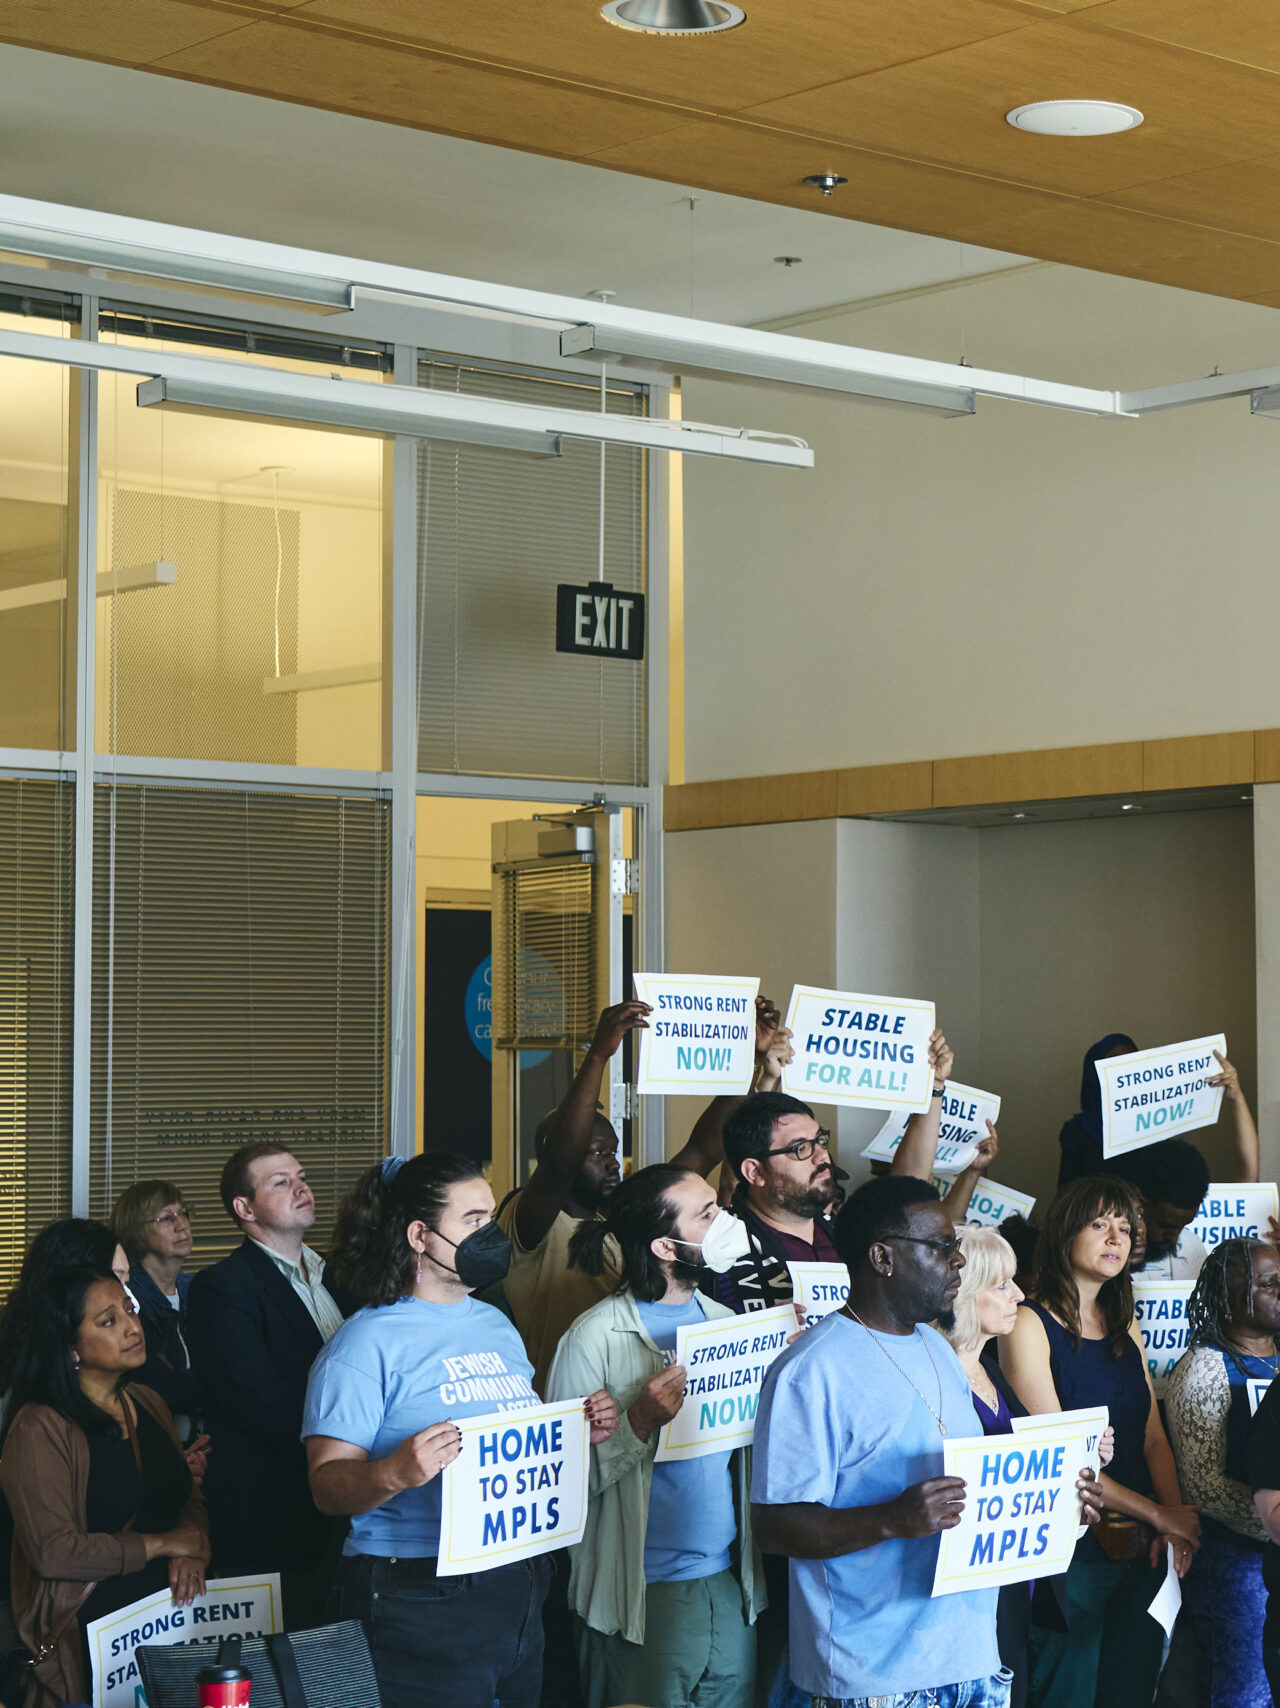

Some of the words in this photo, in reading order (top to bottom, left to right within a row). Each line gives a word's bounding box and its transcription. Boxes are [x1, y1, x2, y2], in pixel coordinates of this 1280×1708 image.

[575, 594, 634, 650] EXIT
[658, 995, 712, 1012] STRONG
[717, 998, 747, 1013] RENT
[655, 1022, 748, 1041] STABILIZATION
[822, 1008, 906, 1035] STABLE
[677, 1046, 731, 1071] NOW!
[806, 1034, 914, 1064] HOUSING
[805, 1062, 851, 1086] FOR
[857, 1069, 908, 1091] ALL!
[1117, 1065, 1174, 1088] STRONG
[1178, 1056, 1212, 1074] RENT
[942, 1095, 977, 1122] ABLE
[1136, 1099, 1194, 1132] NOW!
[1195, 1199, 1245, 1218] ABLE
[690, 1339, 749, 1365] STRONG
[752, 1331, 786, 1353] RENT
[442, 1352, 508, 1381] JEWISH
[479, 1420, 562, 1467] HOME
[479, 1474, 508, 1502] TO
[516, 1461, 563, 1494] STAY
[980, 1446, 1066, 1487] HOME
[977, 1495, 1004, 1522] TO
[1011, 1488, 1061, 1518] STAY
[482, 1497, 559, 1546] MPLS
[969, 1523, 1050, 1567] MPLS
[111, 1610, 185, 1656] STRONG
[193, 1601, 254, 1624] RENT
